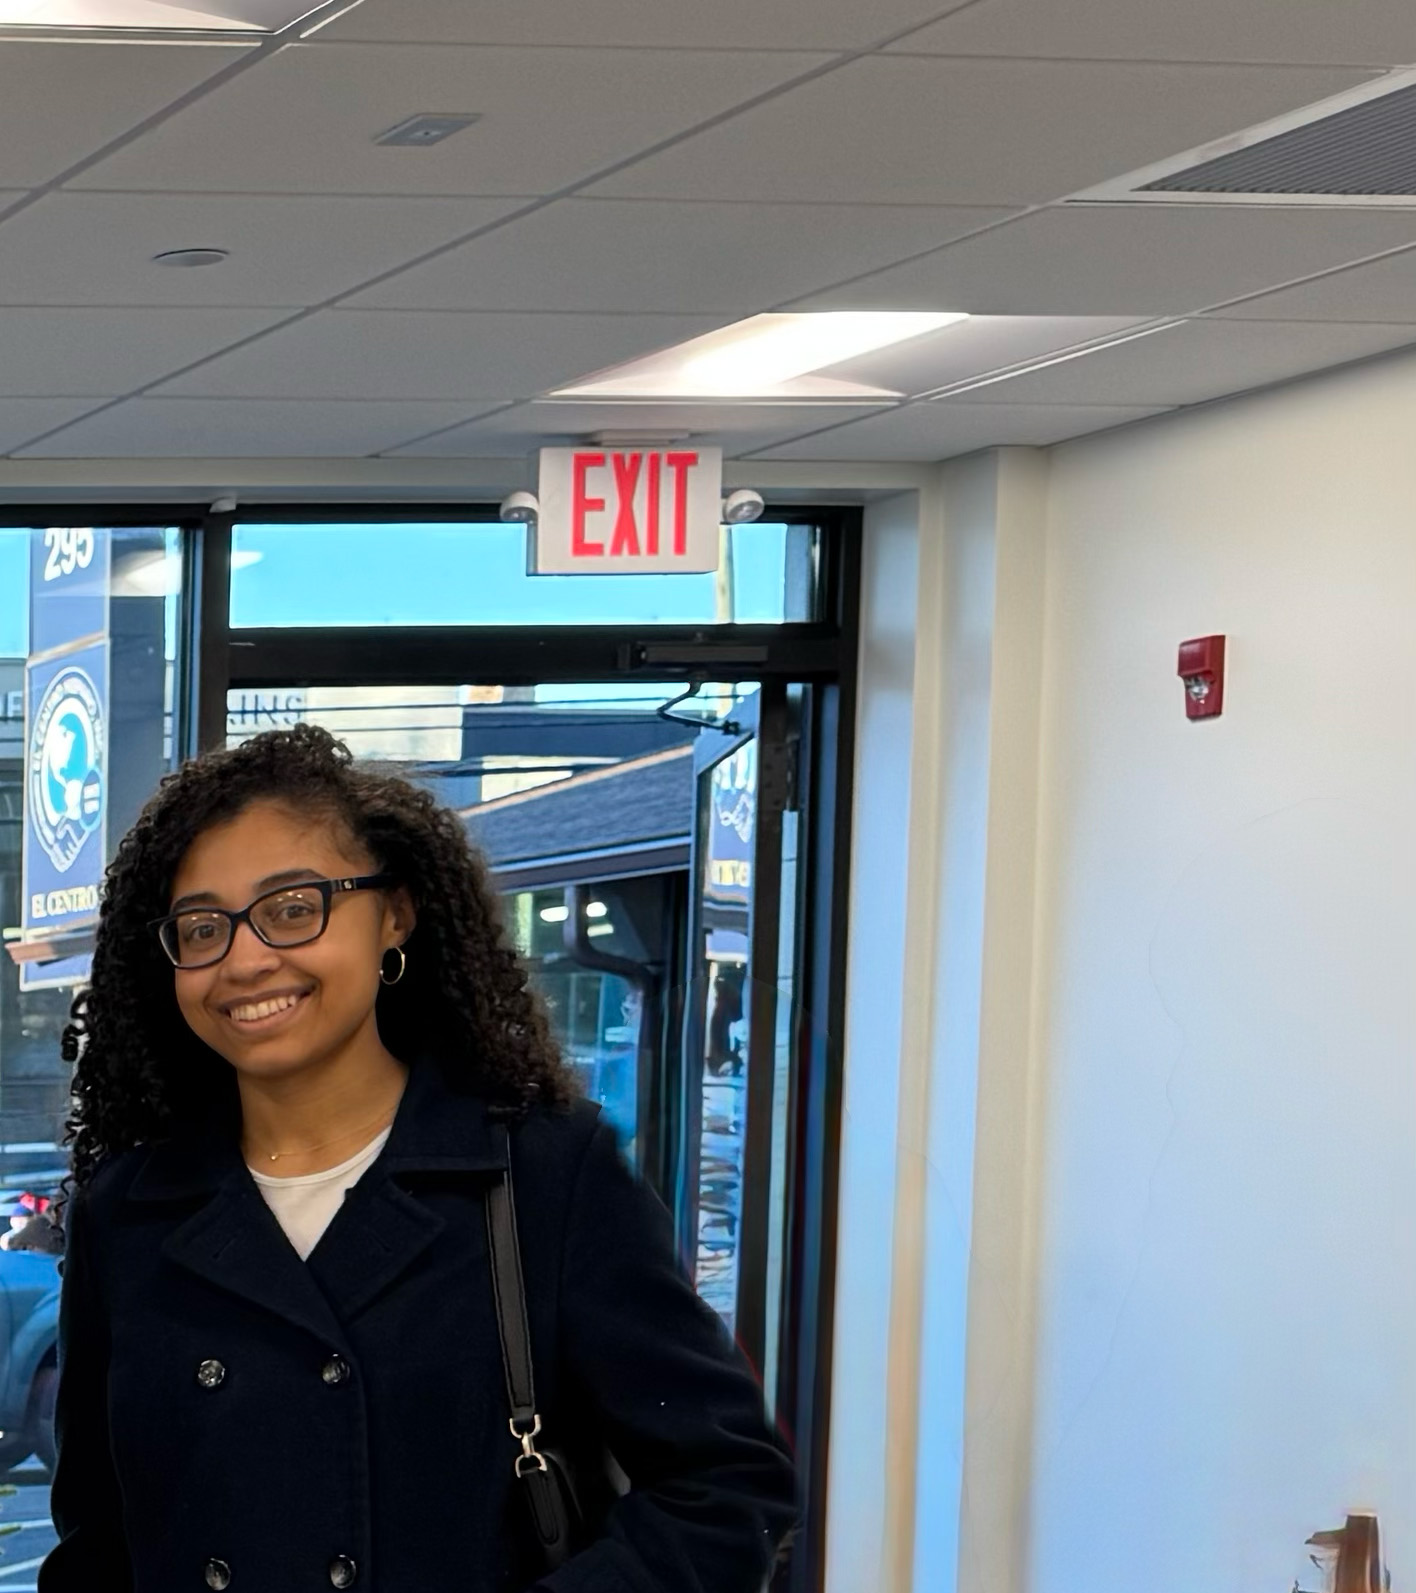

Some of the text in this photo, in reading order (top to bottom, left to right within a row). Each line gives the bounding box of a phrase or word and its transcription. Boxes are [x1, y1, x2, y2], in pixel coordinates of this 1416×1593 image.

[571, 452, 699, 557] EXIT
[44, 527, 94, 582] 295
[46, 884, 99, 916] CENTRO
